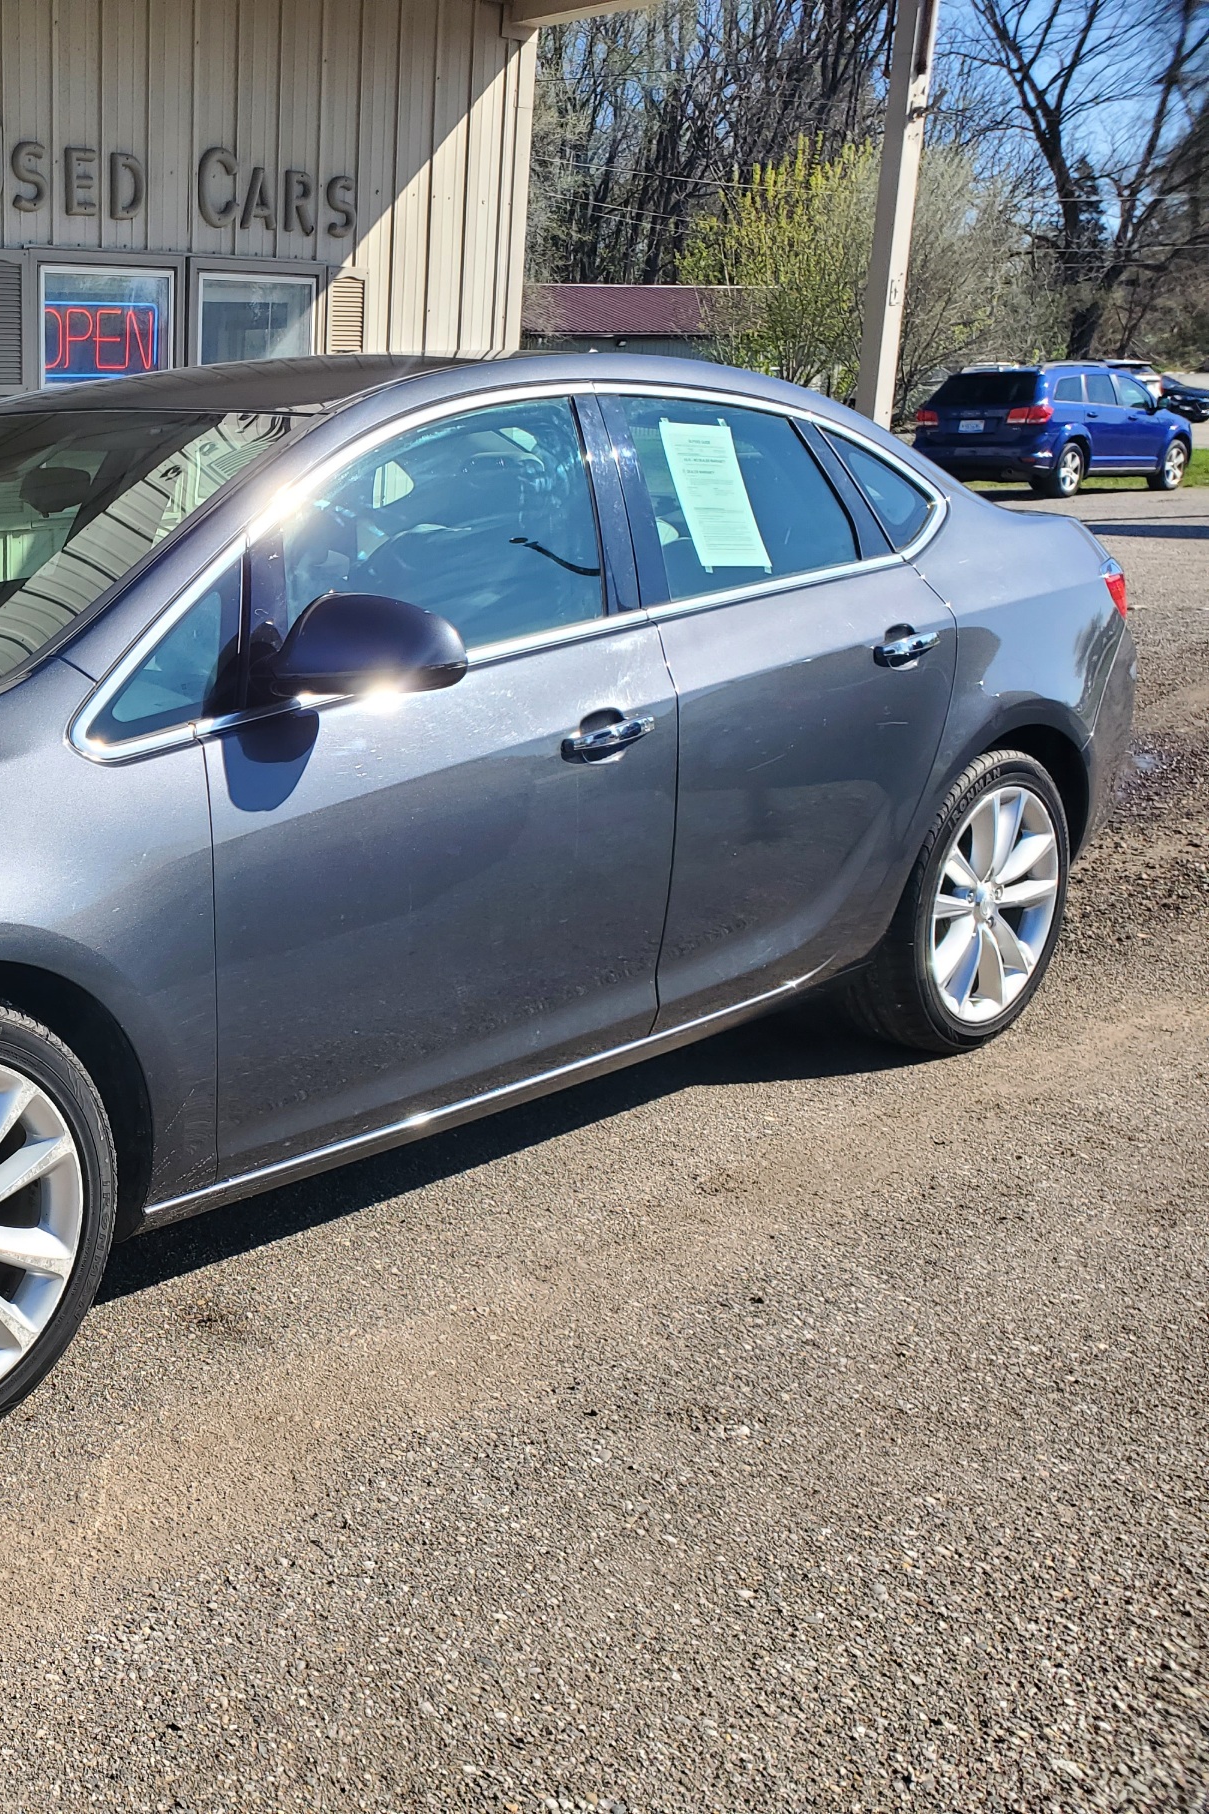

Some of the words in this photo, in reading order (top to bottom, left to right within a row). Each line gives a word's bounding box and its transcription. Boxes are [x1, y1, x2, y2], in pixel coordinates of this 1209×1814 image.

[197, 146, 357, 238] CARS
[44, 307, 154, 371] OPEN
[948, 767, 1001, 830] IRONMAN
